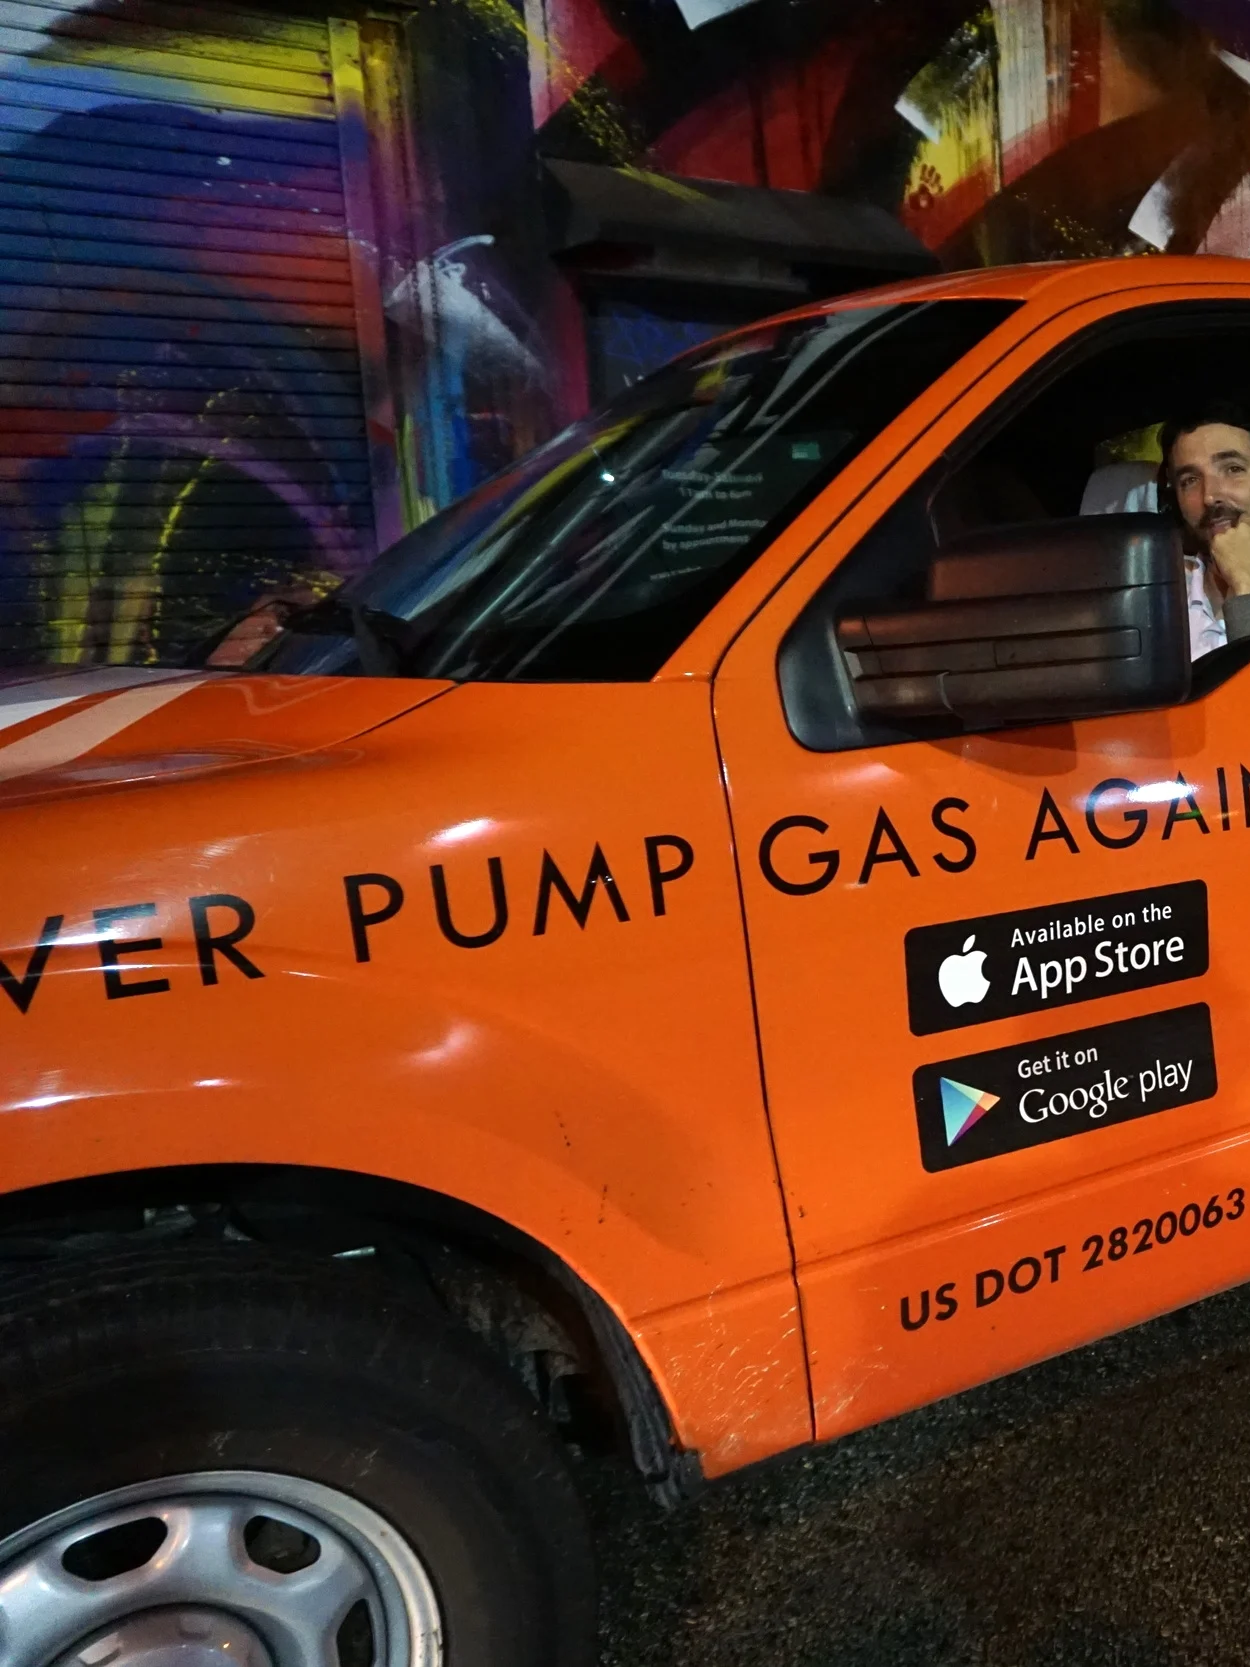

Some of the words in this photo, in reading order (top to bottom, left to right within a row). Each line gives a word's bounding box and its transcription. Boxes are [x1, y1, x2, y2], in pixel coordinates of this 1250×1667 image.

[343, 834, 695, 963] PUMP
[758, 797, 977, 896] GAS
[1011, 914, 1105, 948] Available
[1111, 911, 1136, 929] on
[1142, 903, 1172, 923] the
[1011, 955, 1087, 999] App
[1094, 935, 1184, 978] Store
[1017, 1055, 1052, 1079] Get
[1055, 1051, 1070, 1071] it
[1074, 1047, 1099, 1066] on
[1019, 1069, 1130, 1124] Google
[1139, 1059, 1193, 1102] play
[900, 1282, 958, 1331] US
[975, 1245, 1066, 1308] DOT
[1081, 1187, 1245, 1272] 2820063
